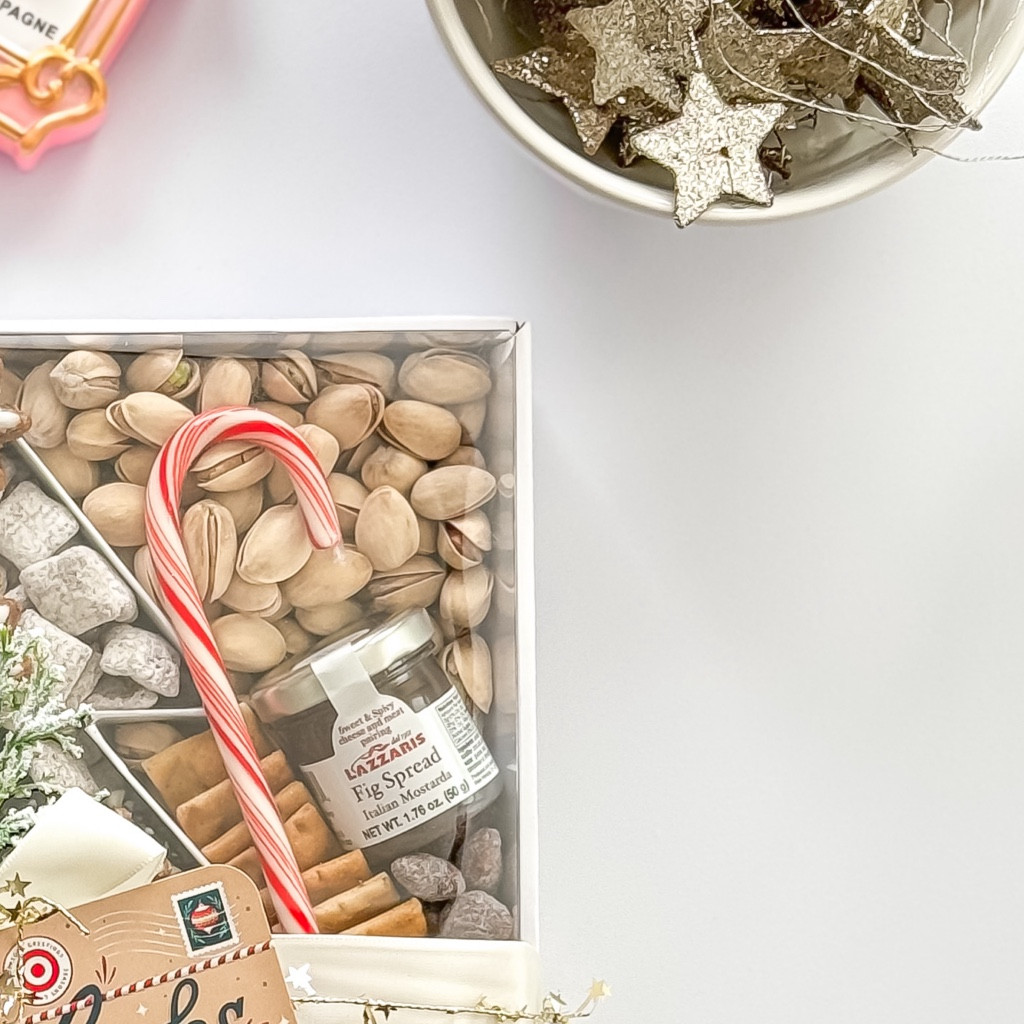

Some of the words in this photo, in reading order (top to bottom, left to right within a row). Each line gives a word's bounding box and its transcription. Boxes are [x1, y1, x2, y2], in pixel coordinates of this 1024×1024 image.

[338, 718, 364, 735] Sweet
[364, 713, 372, 721] &
[372, 702, 395, 718] Spicy
[338, 729, 367, 746] cheese
[367, 717, 384, 732] and
[384, 707, 405, 723] meat
[360, 725, 393, 748] pairing
[344, 732, 426, 781] LAZZARIS
[351, 783, 384, 803] Fig
[382, 745, 442, 790] Spread
[362, 799, 399, 822] Italian
[400, 770, 453, 805] Mostarda
[362, 825, 382, 841] NET
[381, 815, 404, 833] WT.
[403, 804, 426, 824] 1.76
[444, 787, 459, 805] (50
[460, 779, 471, 796] g)
